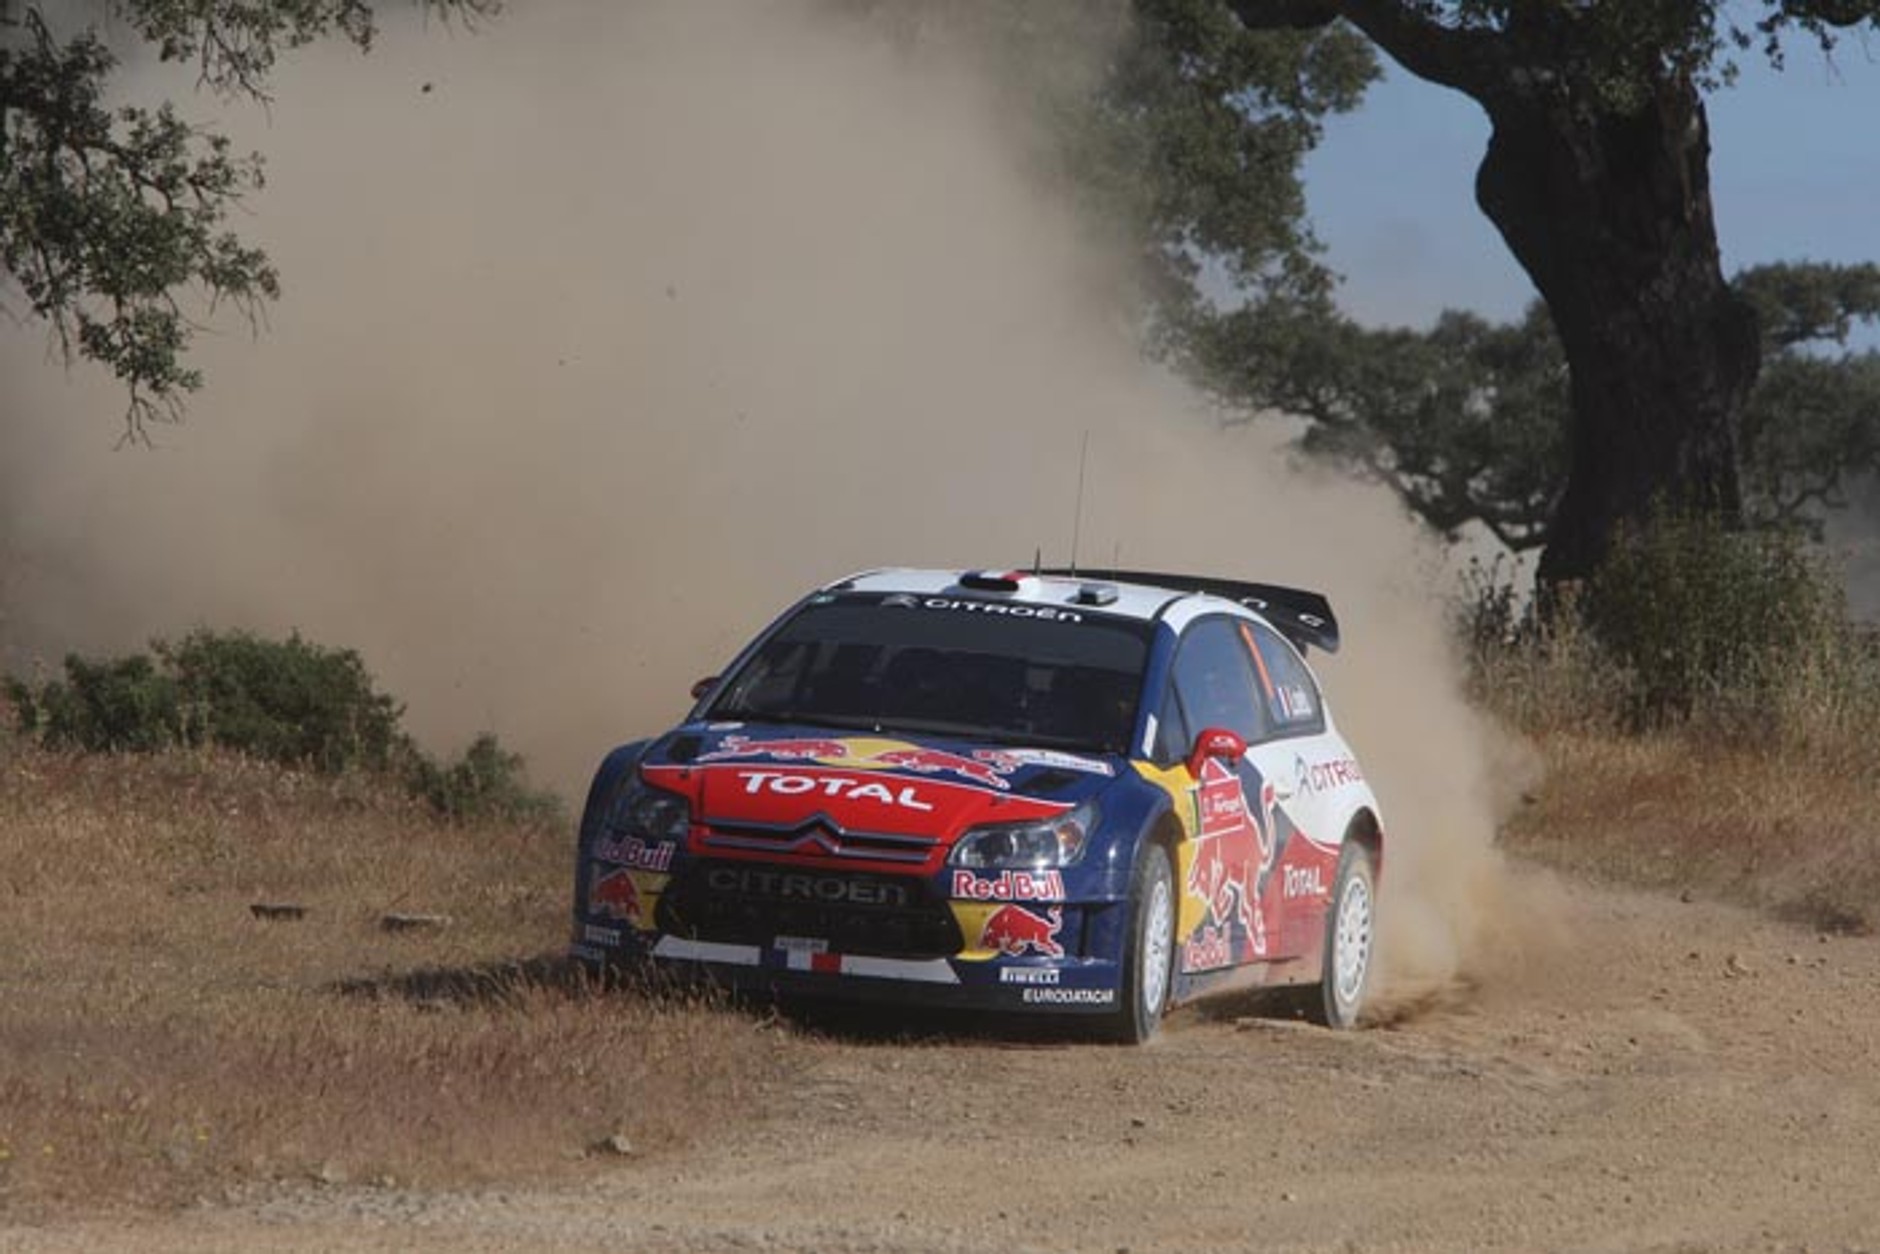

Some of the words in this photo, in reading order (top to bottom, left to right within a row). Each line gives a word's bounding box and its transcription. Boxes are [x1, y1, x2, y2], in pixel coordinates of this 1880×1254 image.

[737, 771, 934, 811] TOTAL
[952, 869, 1012, 899] Red
[1012, 869, 1066, 901] Bull
[1283, 863, 1328, 898] TOTAL
